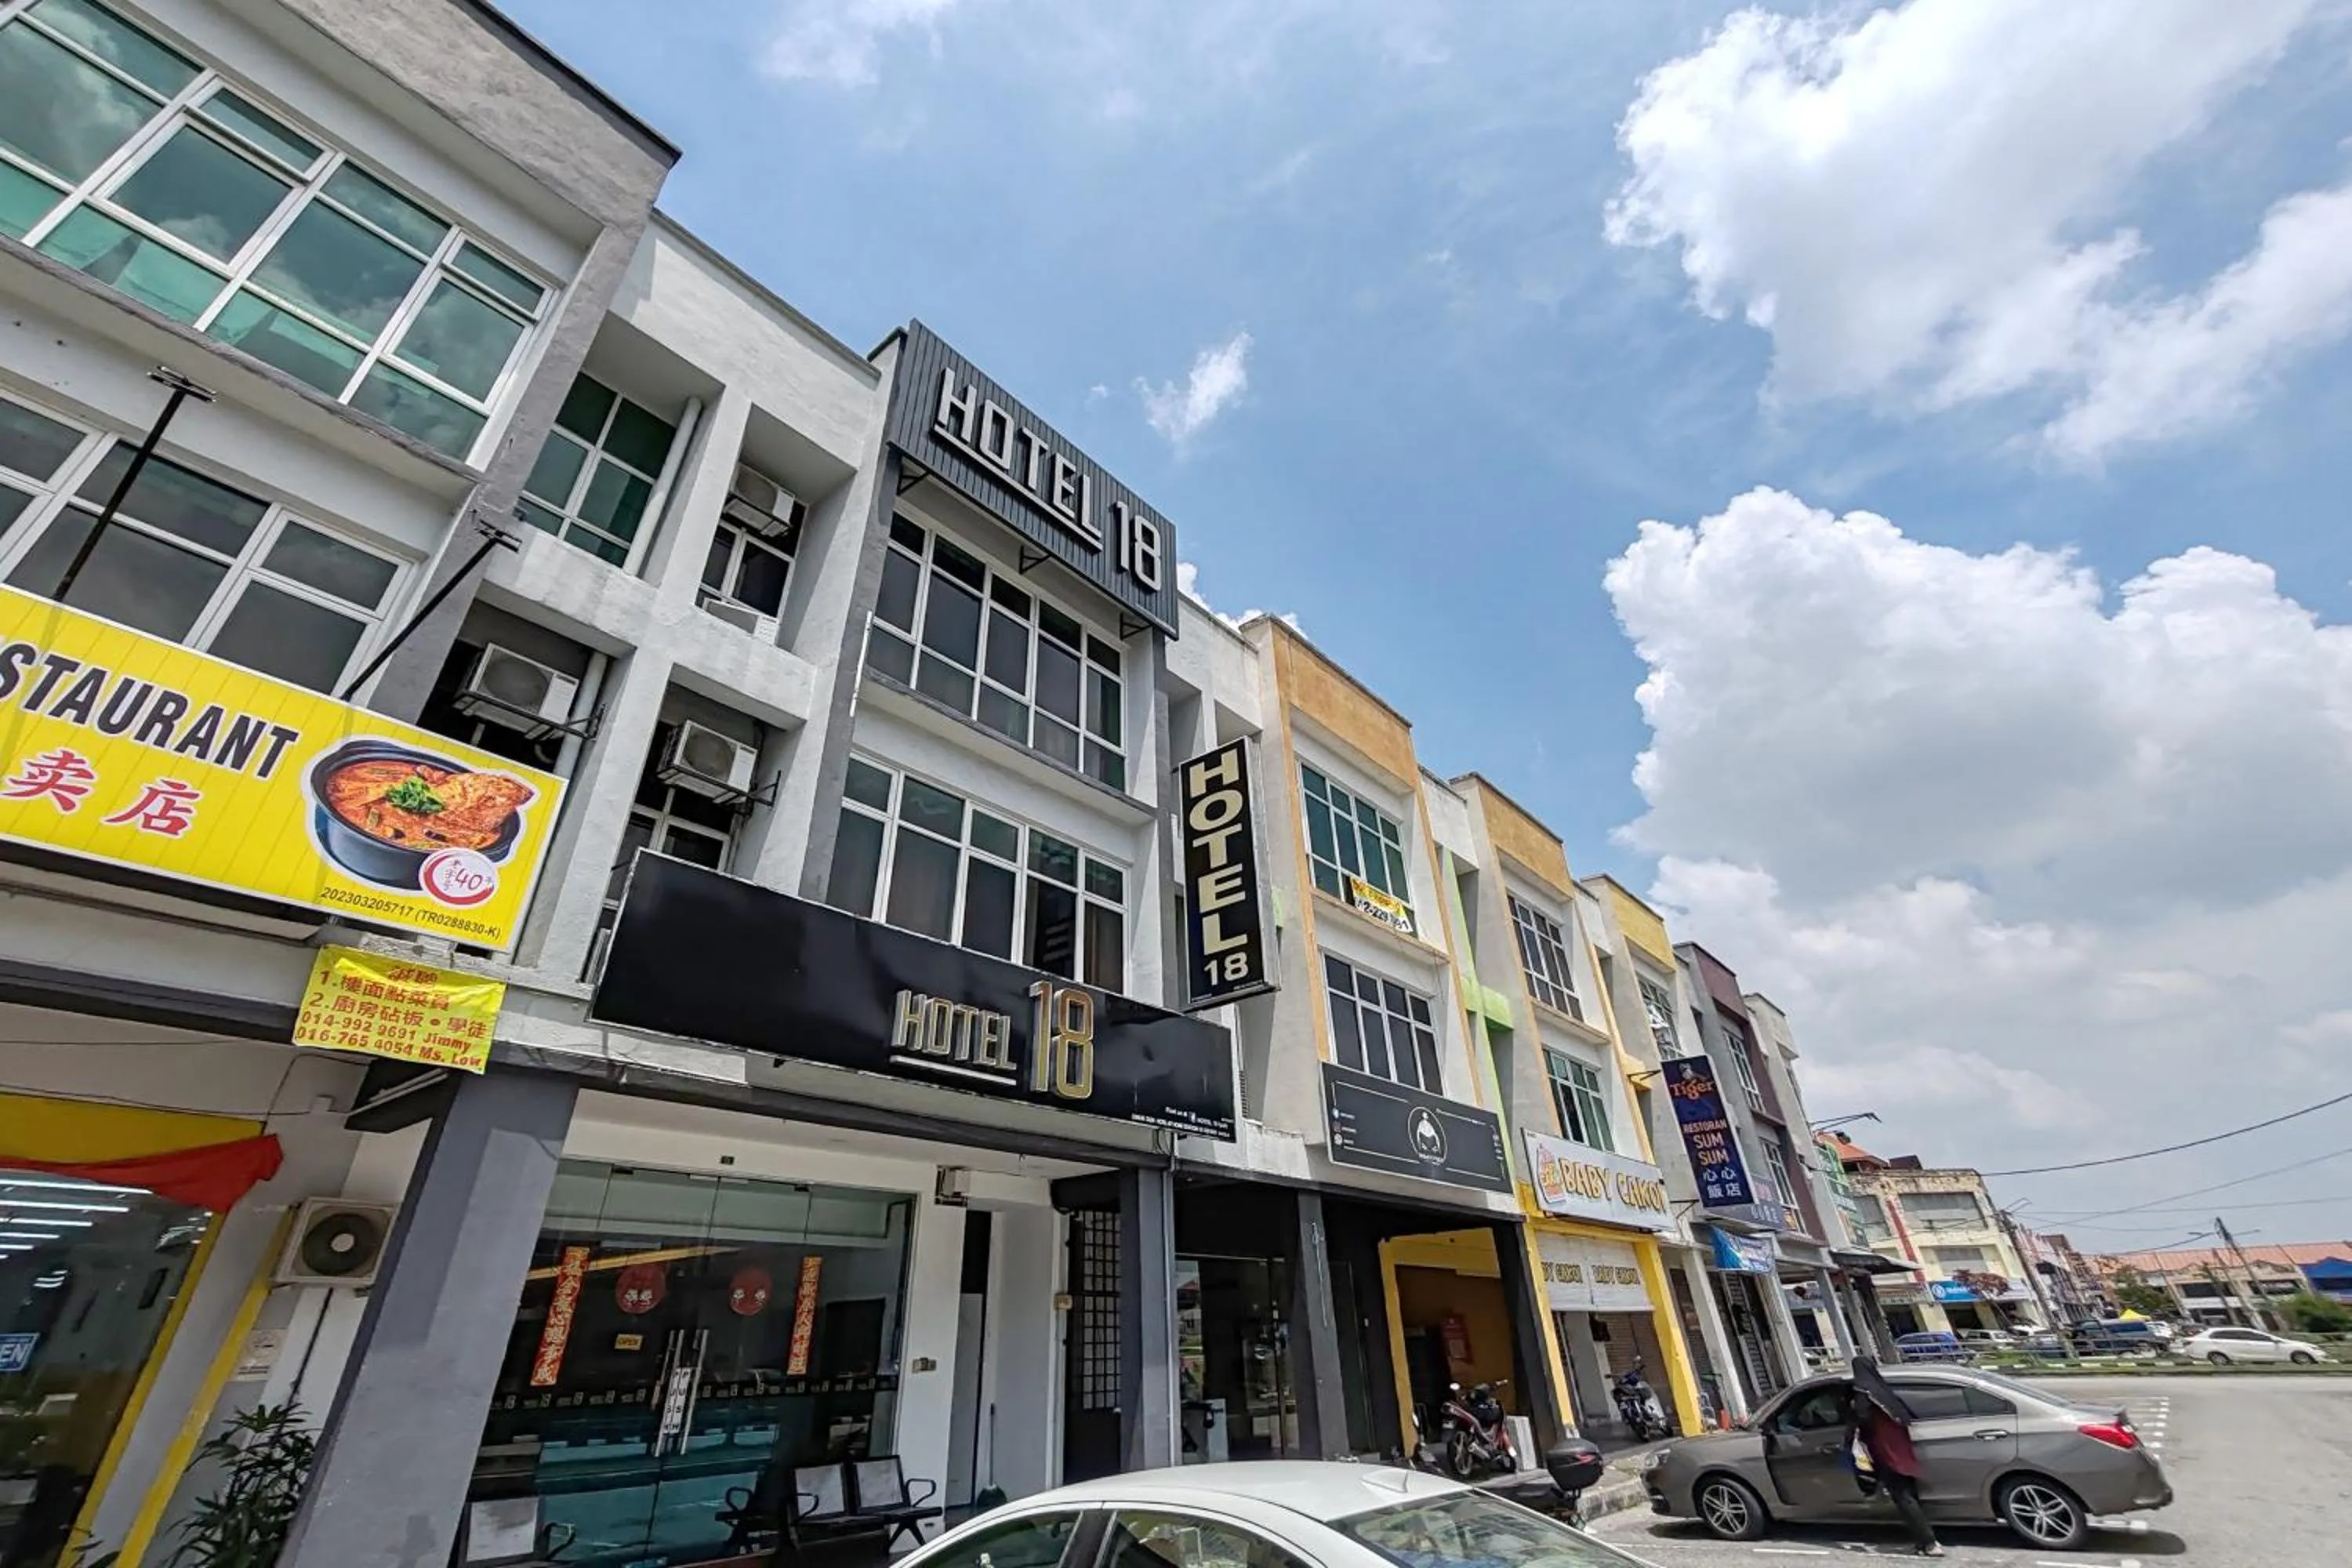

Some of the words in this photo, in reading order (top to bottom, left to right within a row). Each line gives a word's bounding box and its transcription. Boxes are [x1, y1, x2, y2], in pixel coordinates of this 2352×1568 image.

[935, 367, 1103, 539] HOTEL
[1115, 500, 1163, 592] 18
[0, 644, 299, 779] STAURANT
[1189, 748, 1249, 956] HOTEL
[455, 868, 484, 891] 40
[321, 887, 414, 917] 202303205717
[1203, 951, 1249, 985] 18
[296, 1026, 368, 1047] 016-765
[374, 1040, 414, 1056] 4054
[418, 1045, 446, 1062] Ms.
[302, 1011, 372, 1033] 014-992
[423, 1033, 473, 1054] Jimmy
[891, 989, 1018, 1071] HOTEL
[1029, 979, 1095, 1099] 18
[1670, 1079, 1715, 1101] Tiger
[1682, 1119, 1728, 1134] RESTORAN
[1693, 1133, 1726, 1149] SUM
[1697, 1149, 1730, 1166] SUM
[1558, 1158, 1612, 1202] BABY
